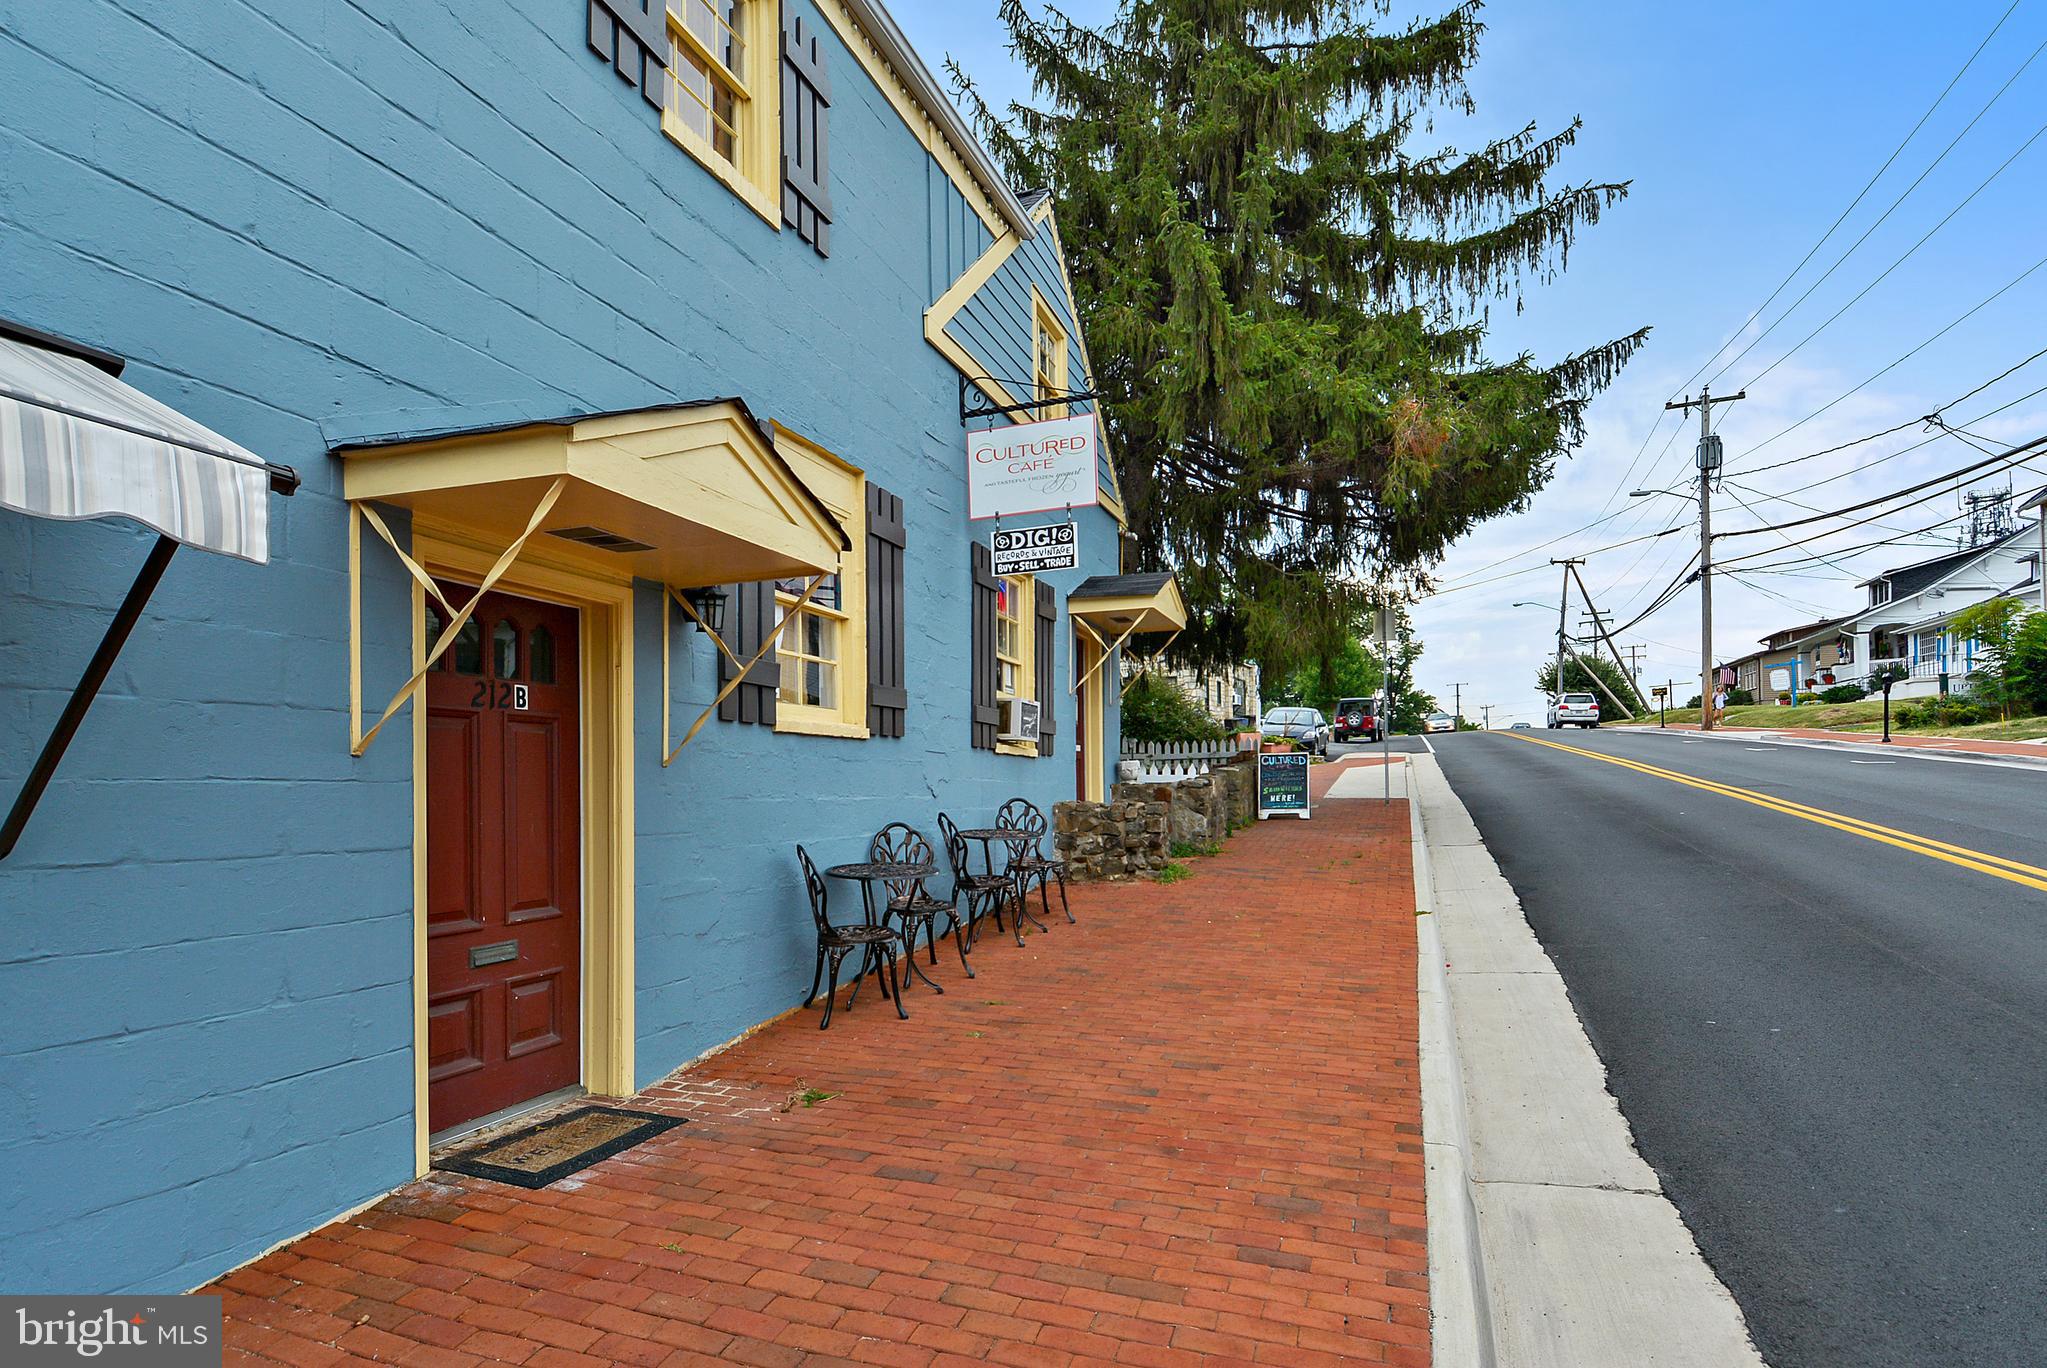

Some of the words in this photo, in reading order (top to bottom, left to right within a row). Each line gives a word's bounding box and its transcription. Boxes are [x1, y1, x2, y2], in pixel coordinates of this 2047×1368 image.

[975, 436, 1086, 463] CULTURED
[1007, 455, 1055, 474] CAFÉ
[1010, 528, 1058, 549] DIG!
[997, 550, 1030, 562] RECORDS
[1031, 549, 1038, 557] &
[1039, 545, 1071, 557] VINTAGE
[997, 563, 1015, 573] BUY
[1018, 560, 1040, 571] SELL
[1044, 556, 1072, 568] TRADE
[1261, 755, 1306, 765] CULTURED
[1270, 794, 1296, 802] HERE!
